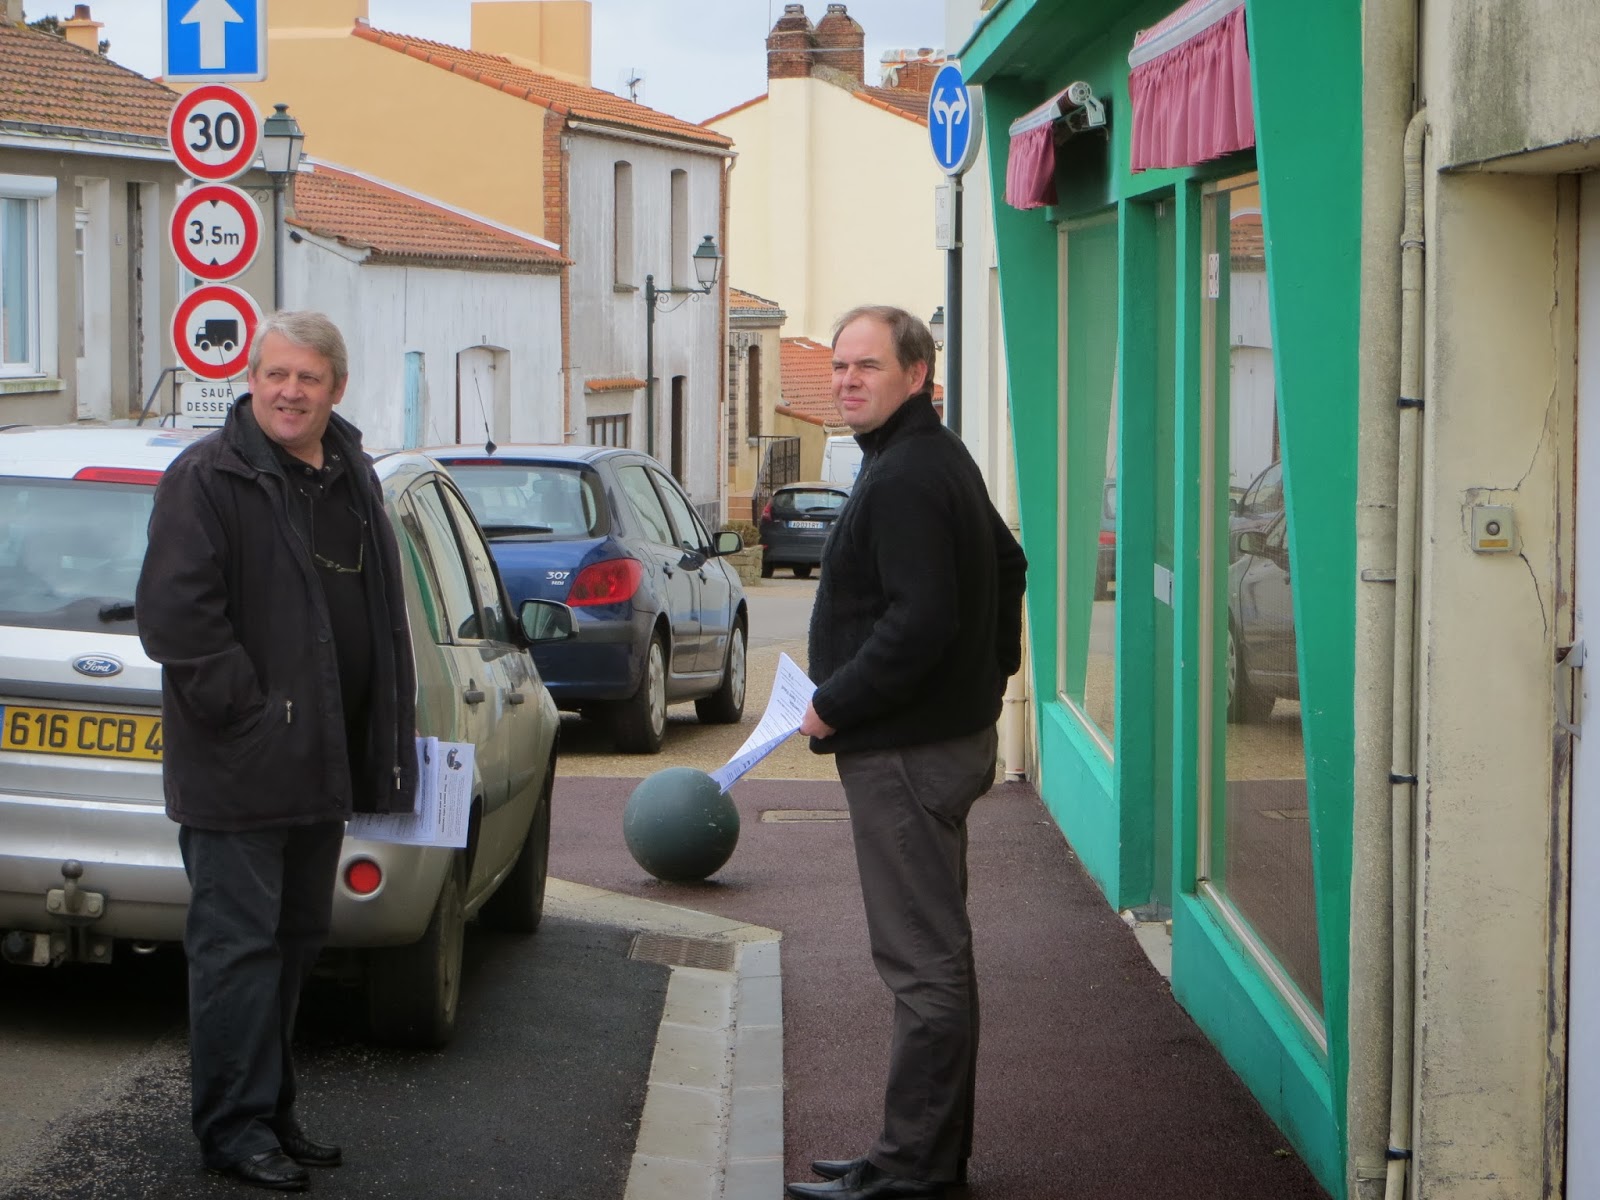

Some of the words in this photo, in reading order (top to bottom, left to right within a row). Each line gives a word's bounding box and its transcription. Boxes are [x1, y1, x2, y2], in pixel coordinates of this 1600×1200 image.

[189, 112, 241, 153] 30
[189, 219, 240, 247] 3,5m
[201, 387, 233, 398] SAUF
[546, 571, 570, 580] 307
[82, 659, 111, 673] Ford
[10, 711, 69, 748] 616
[77, 716, 137, 753] CCB
